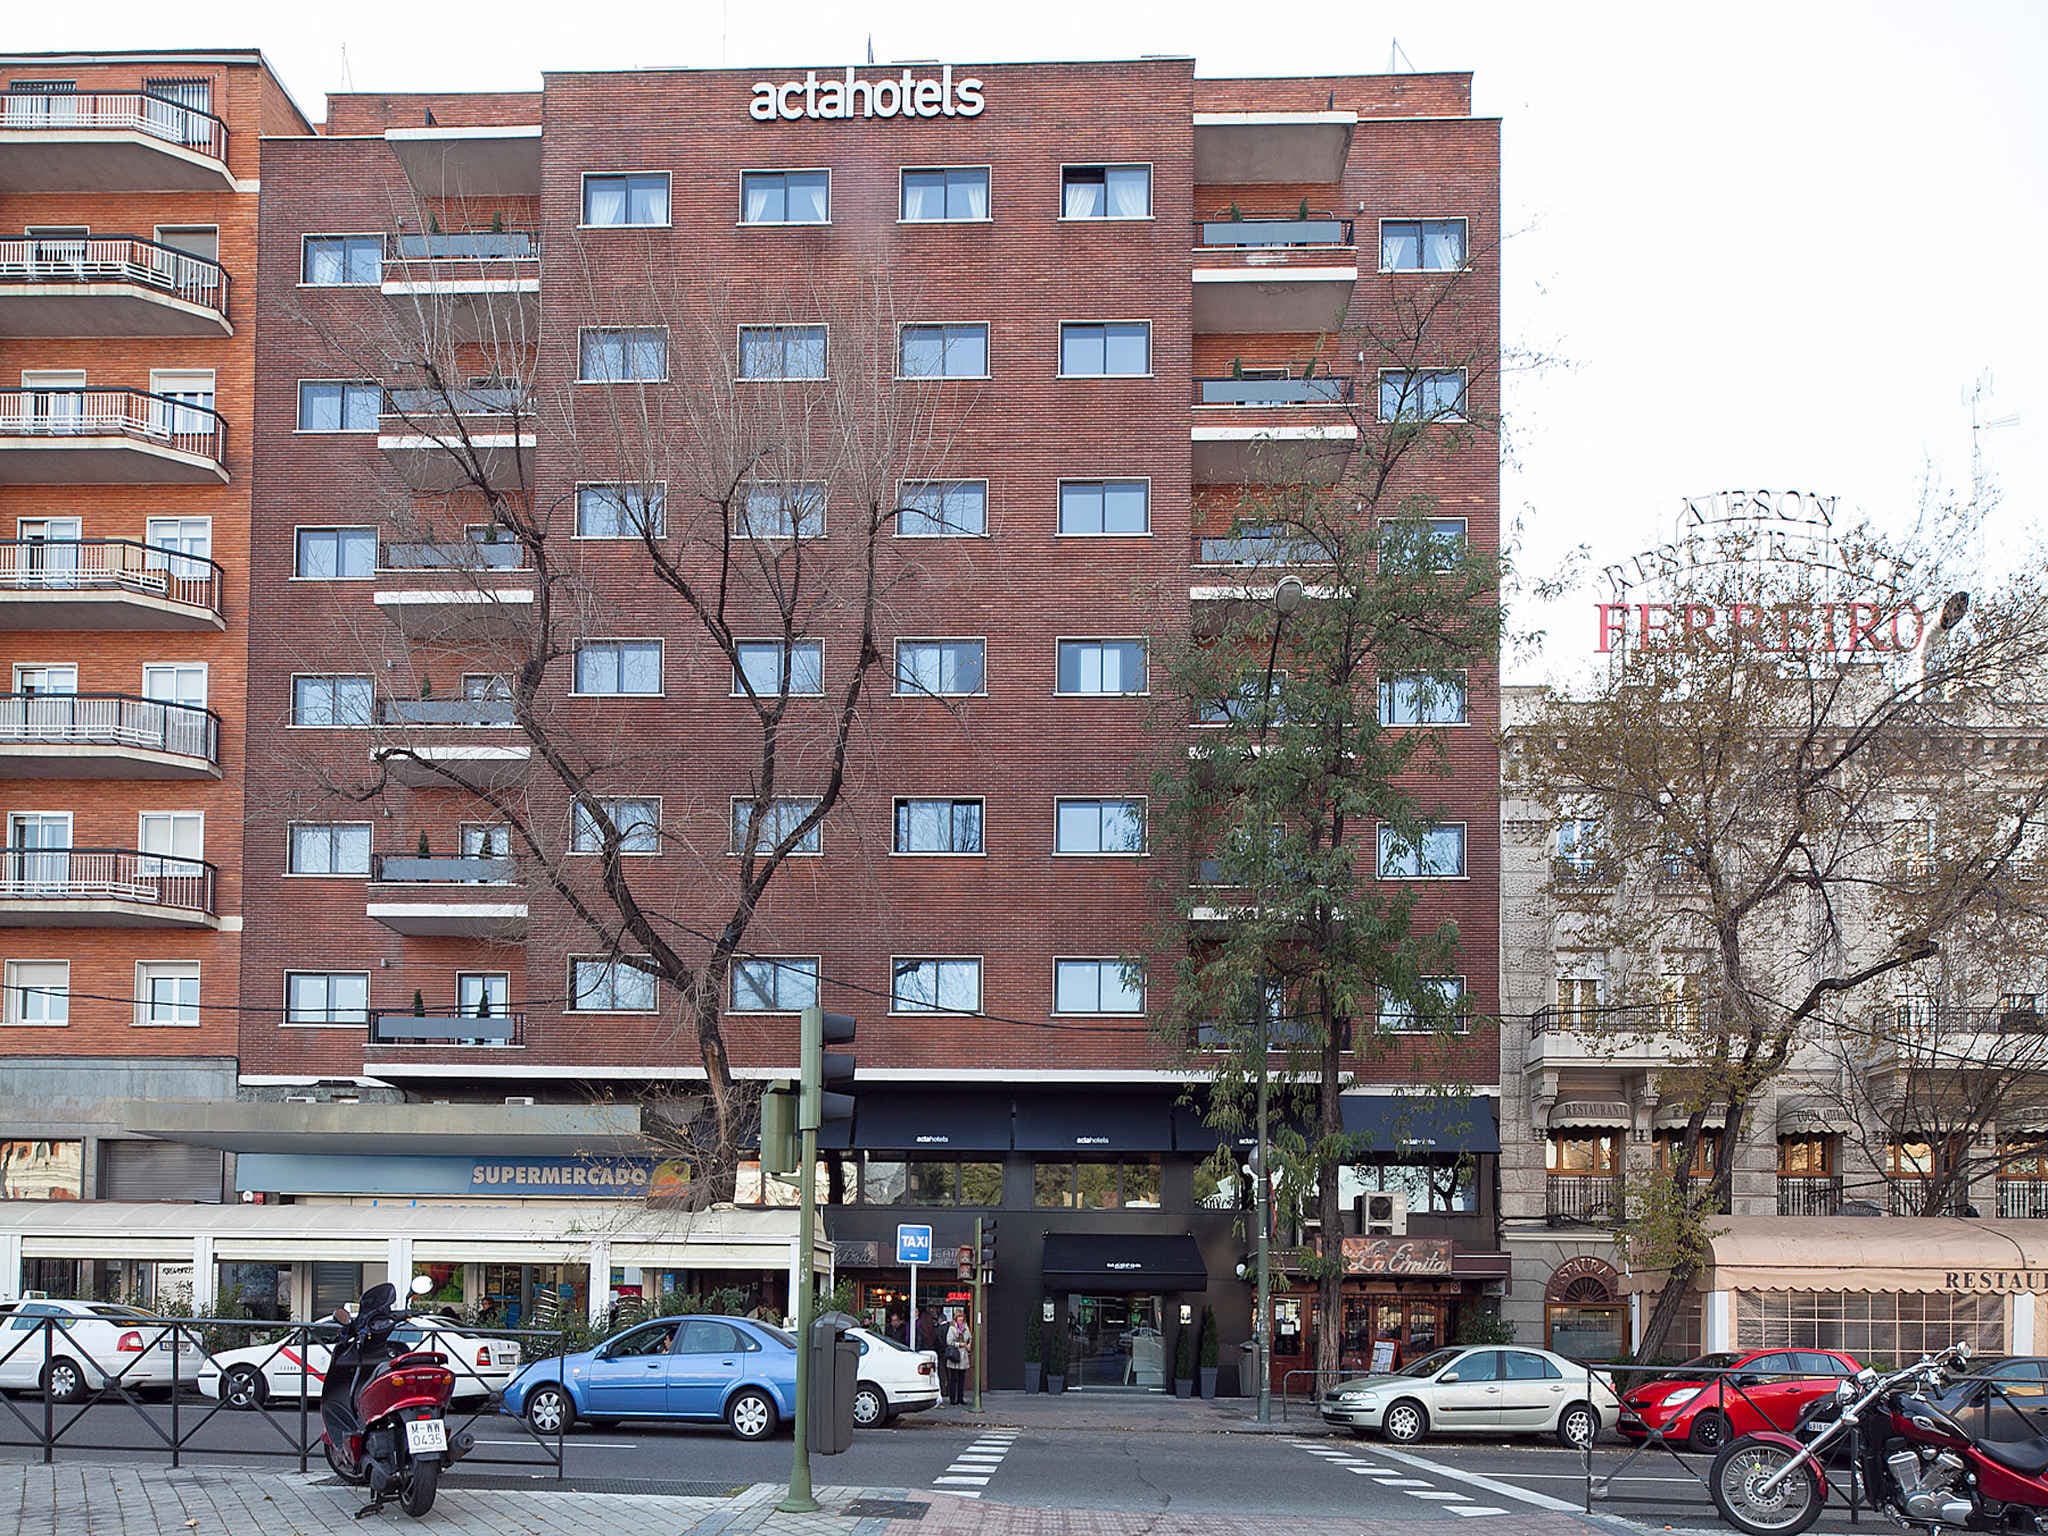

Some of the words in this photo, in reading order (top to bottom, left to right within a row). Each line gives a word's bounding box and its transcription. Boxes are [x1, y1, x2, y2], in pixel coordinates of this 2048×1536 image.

[749, 65, 985, 120] actahotels
[1594, 603, 1924, 652] FERREIRO
[916, 1135, 949, 1144] actahotels
[472, 1166, 648, 1187] SUPERMERCADO
[901, 1235, 929, 1248] TAXI
[413, 1434, 442, 1446] 0435
